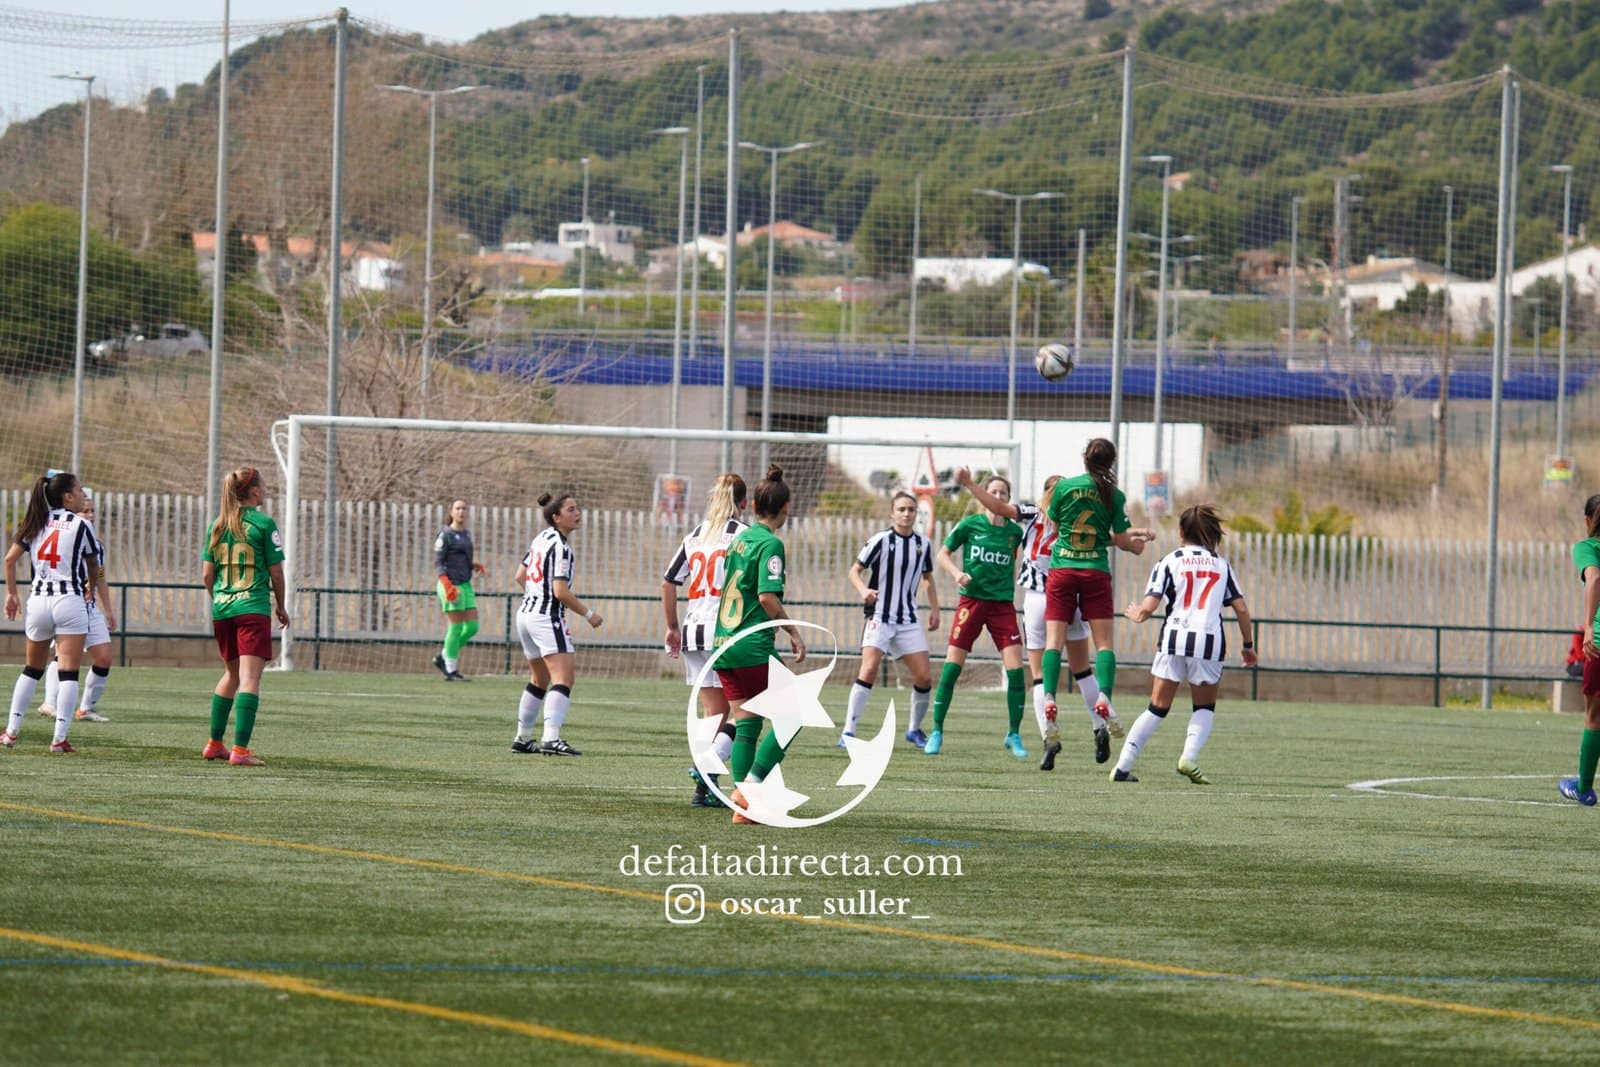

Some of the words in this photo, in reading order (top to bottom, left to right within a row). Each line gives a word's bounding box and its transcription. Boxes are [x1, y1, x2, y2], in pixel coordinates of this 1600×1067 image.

[37, 529, 61, 570] 4
[1070, 510, 1097, 551] 6
[214, 542, 255, 590] 10
[688, 548, 727, 601] 20
[970, 544, 1010, 566] Platzi
[1180, 570, 1221, 612] 17
[958, 607, 970, 625] 9
